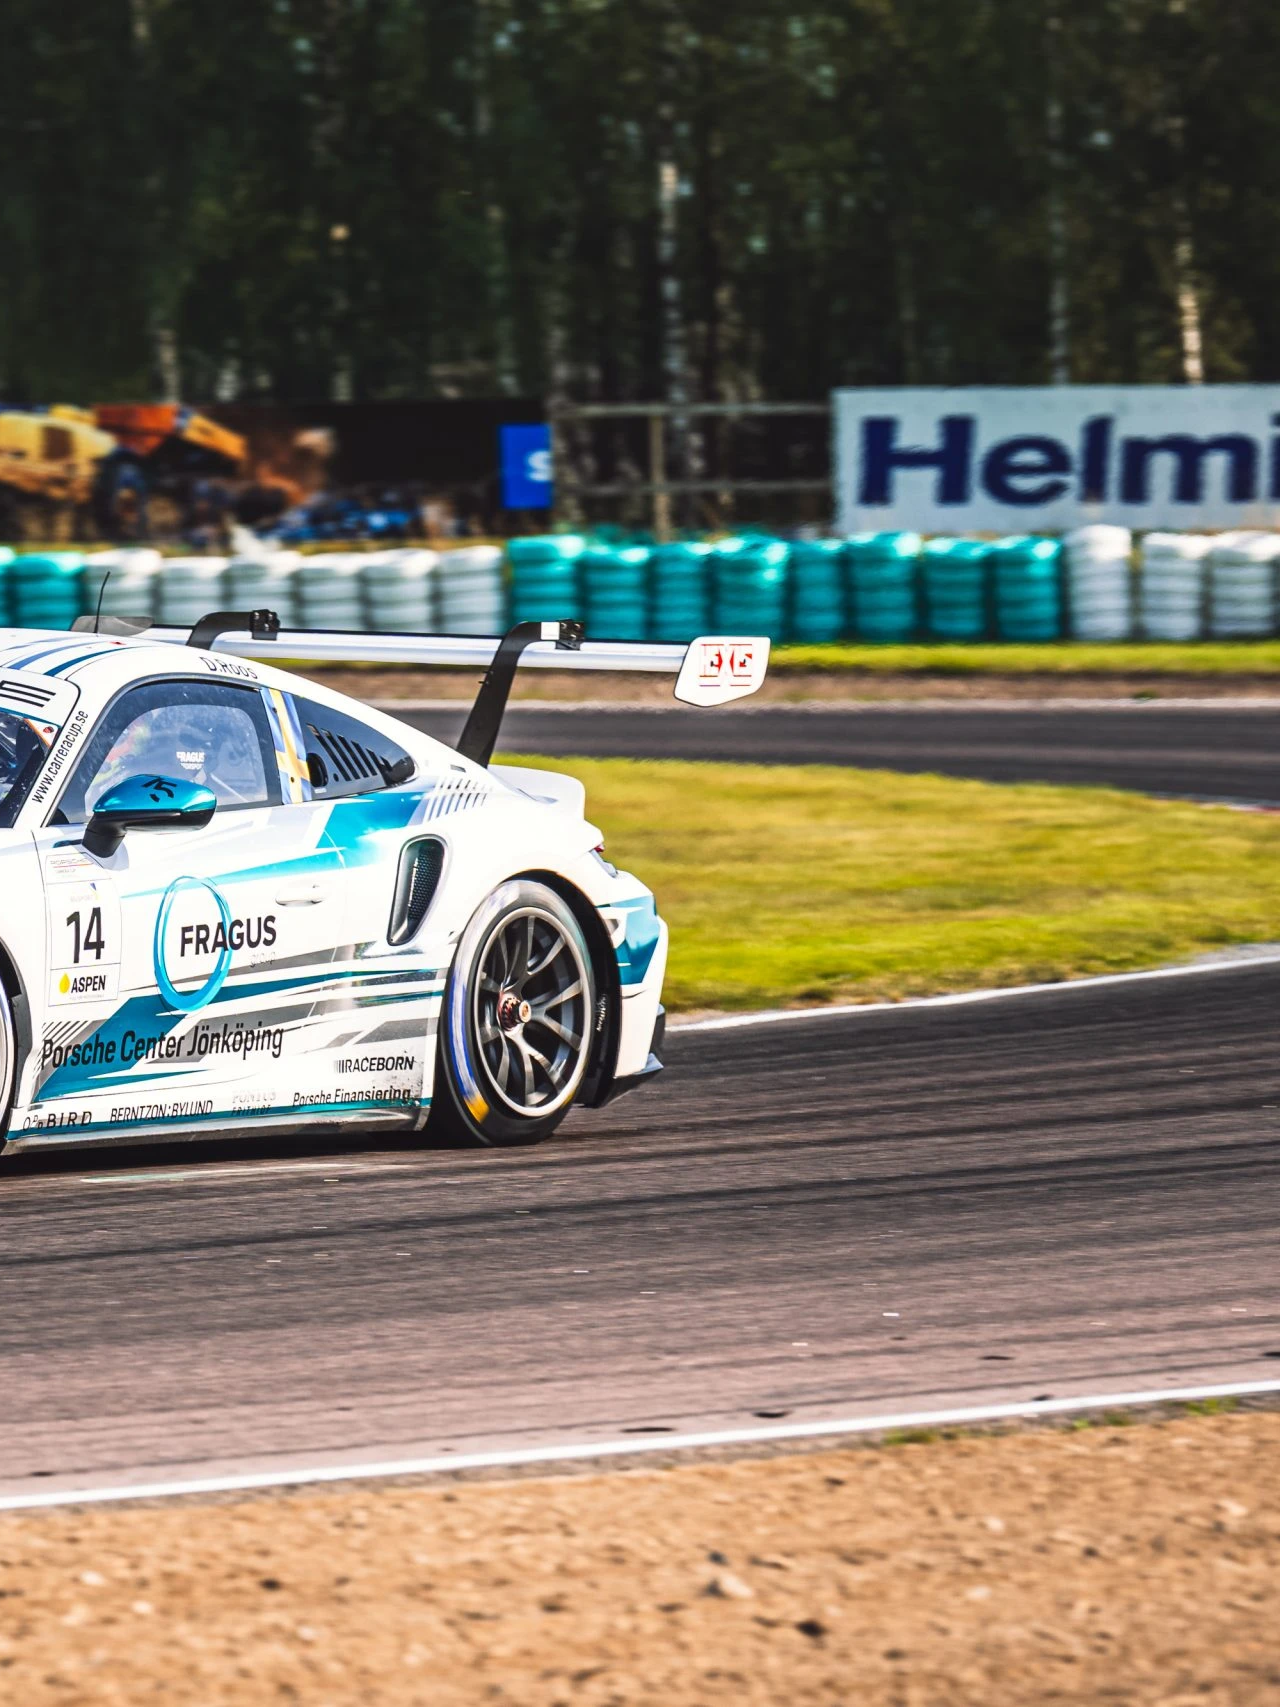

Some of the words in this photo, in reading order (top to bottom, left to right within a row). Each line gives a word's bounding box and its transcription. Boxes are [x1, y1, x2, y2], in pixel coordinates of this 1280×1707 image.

[31, 710, 89, 804] www.carreracup.se
[66, 906, 105, 964] 14
[180, 915, 277, 957] FRAGUS
[71, 975, 106, 993] ASPEN
[41, 1033, 116, 1071] Porsche
[121, 1030, 185, 1063] Center
[186, 1021, 284, 1061] Jönköping
[344, 1056, 415, 1073] RACEBORN
[292, 1090, 331, 1107] Porsche
